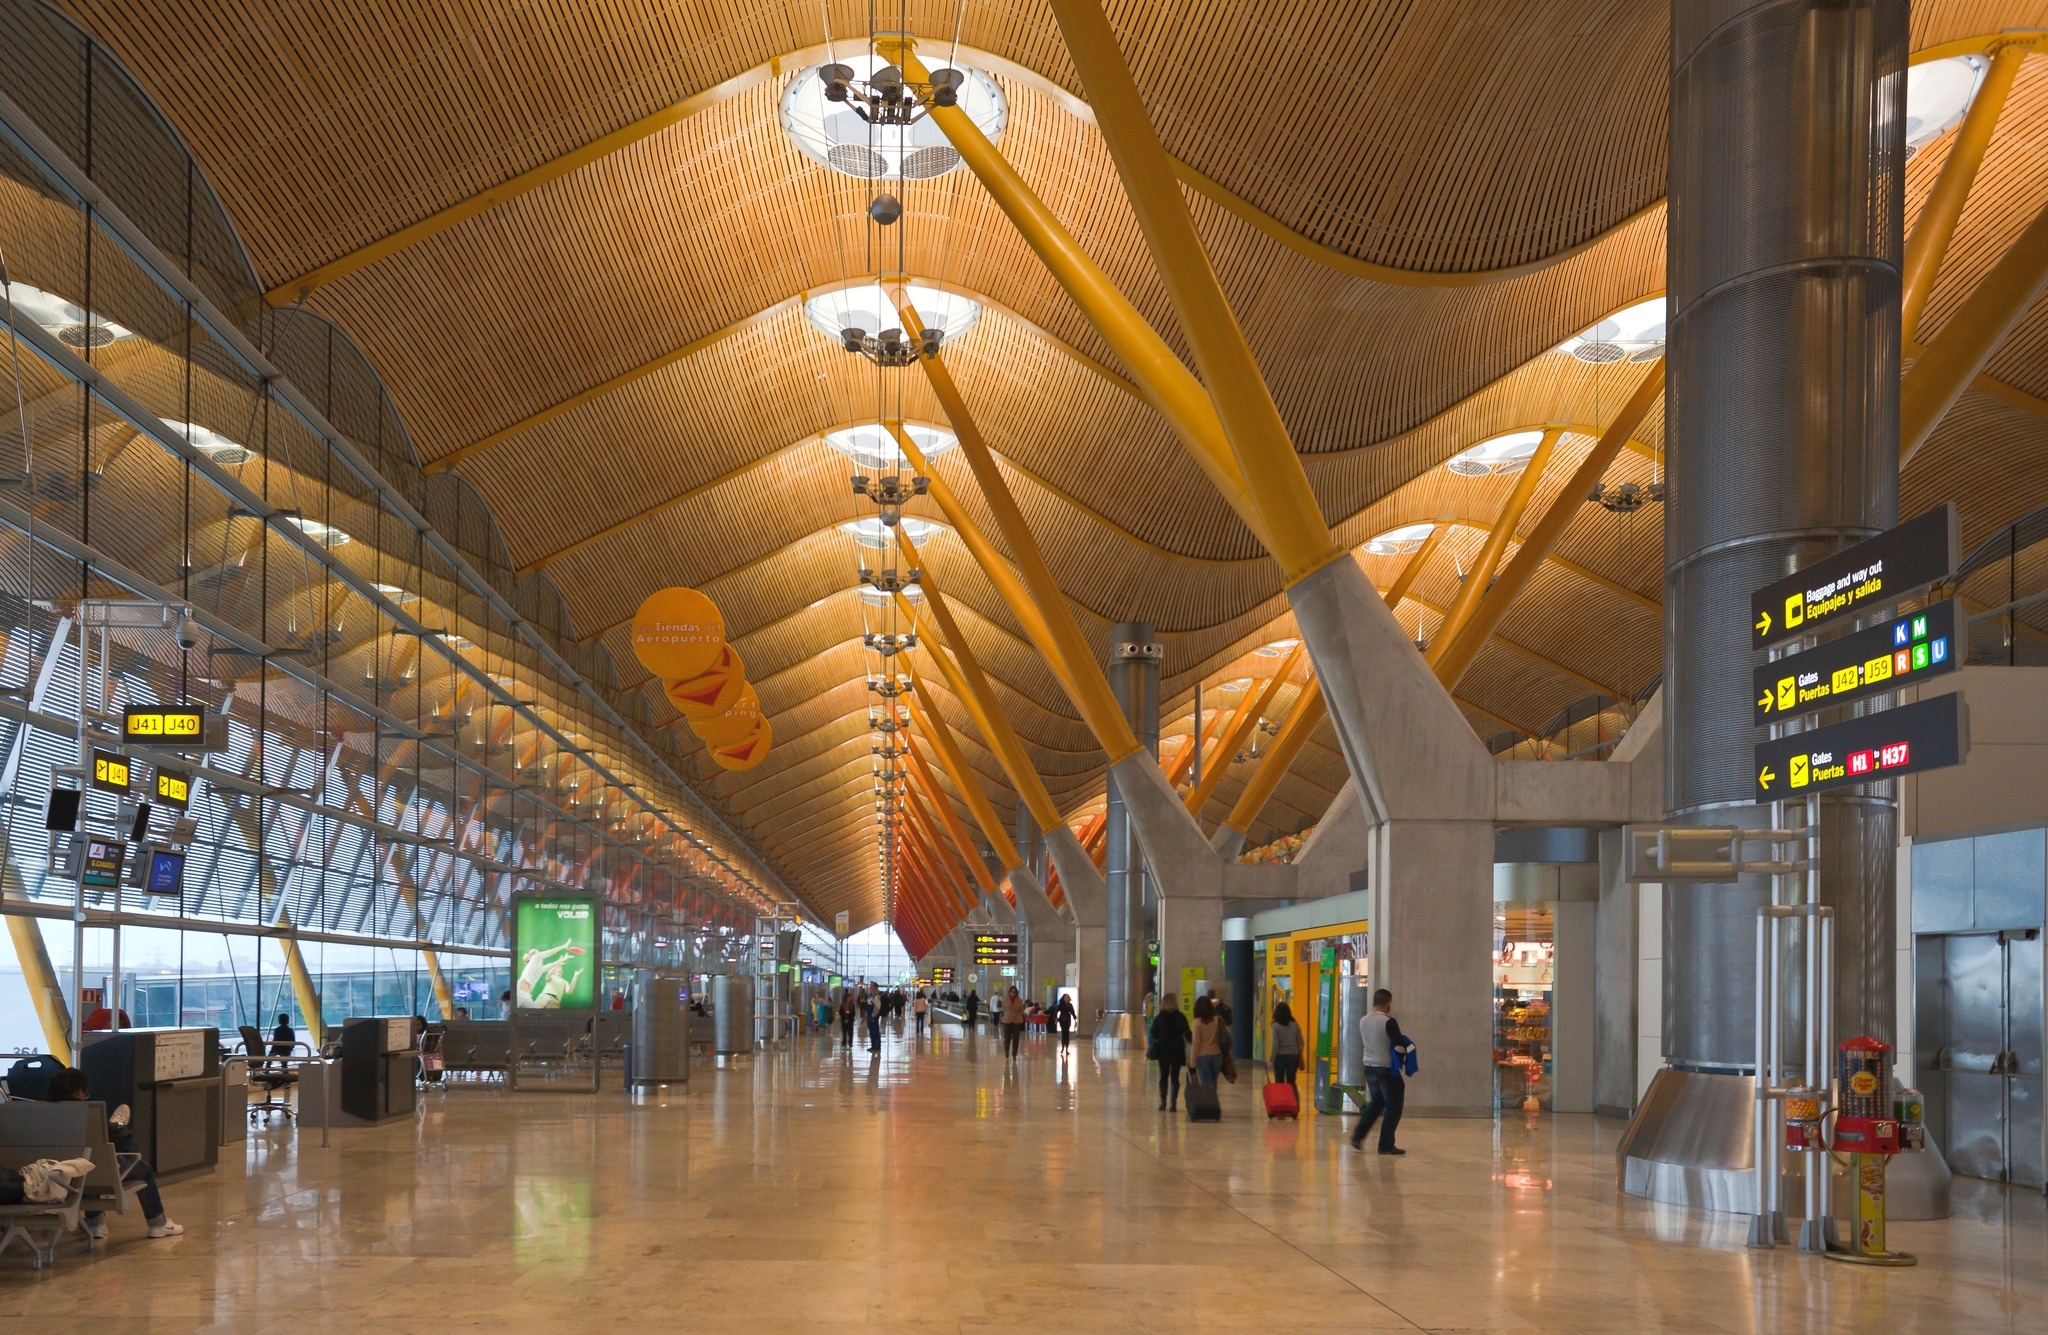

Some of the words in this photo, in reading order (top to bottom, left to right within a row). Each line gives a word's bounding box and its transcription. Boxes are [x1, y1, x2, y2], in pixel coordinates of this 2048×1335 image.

[1806, 582, 1836, 603] Baggage
[1837, 574, 1851, 592] and
[1852, 569, 1868, 585] way
[1869, 560, 1883, 577] out
[1807, 595, 1846, 620] Equipajes
[1847, 593, 1854, 606] y
[1855, 577, 1882, 600] salida
[655, 622, 700, 632] Tiendas
[1896, 625, 1906, 642] K
[1914, 619, 1926, 637] M
[636, 634, 720, 644] Aeropuerto
[1897, 654, 1907, 671] R
[1916, 648, 1925, 665] S
[1935, 641, 1944, 659] U
[1798, 671, 1818, 687] Gates
[1799, 684, 1830, 703] Puertas
[1836, 671, 1855, 689] J42
[1868, 659, 1888, 679] J59
[133, 718, 157, 731] J41
[169, 718, 195, 731] J40
[1812, 751, 1832, 766] Gates
[1813, 765, 1844, 782] Puertas
[1853, 753, 1867, 772] H1
[1882, 744, 1906, 766] H37
[112, 769, 125, 783] J41
[171, 783, 186, 798] J40
